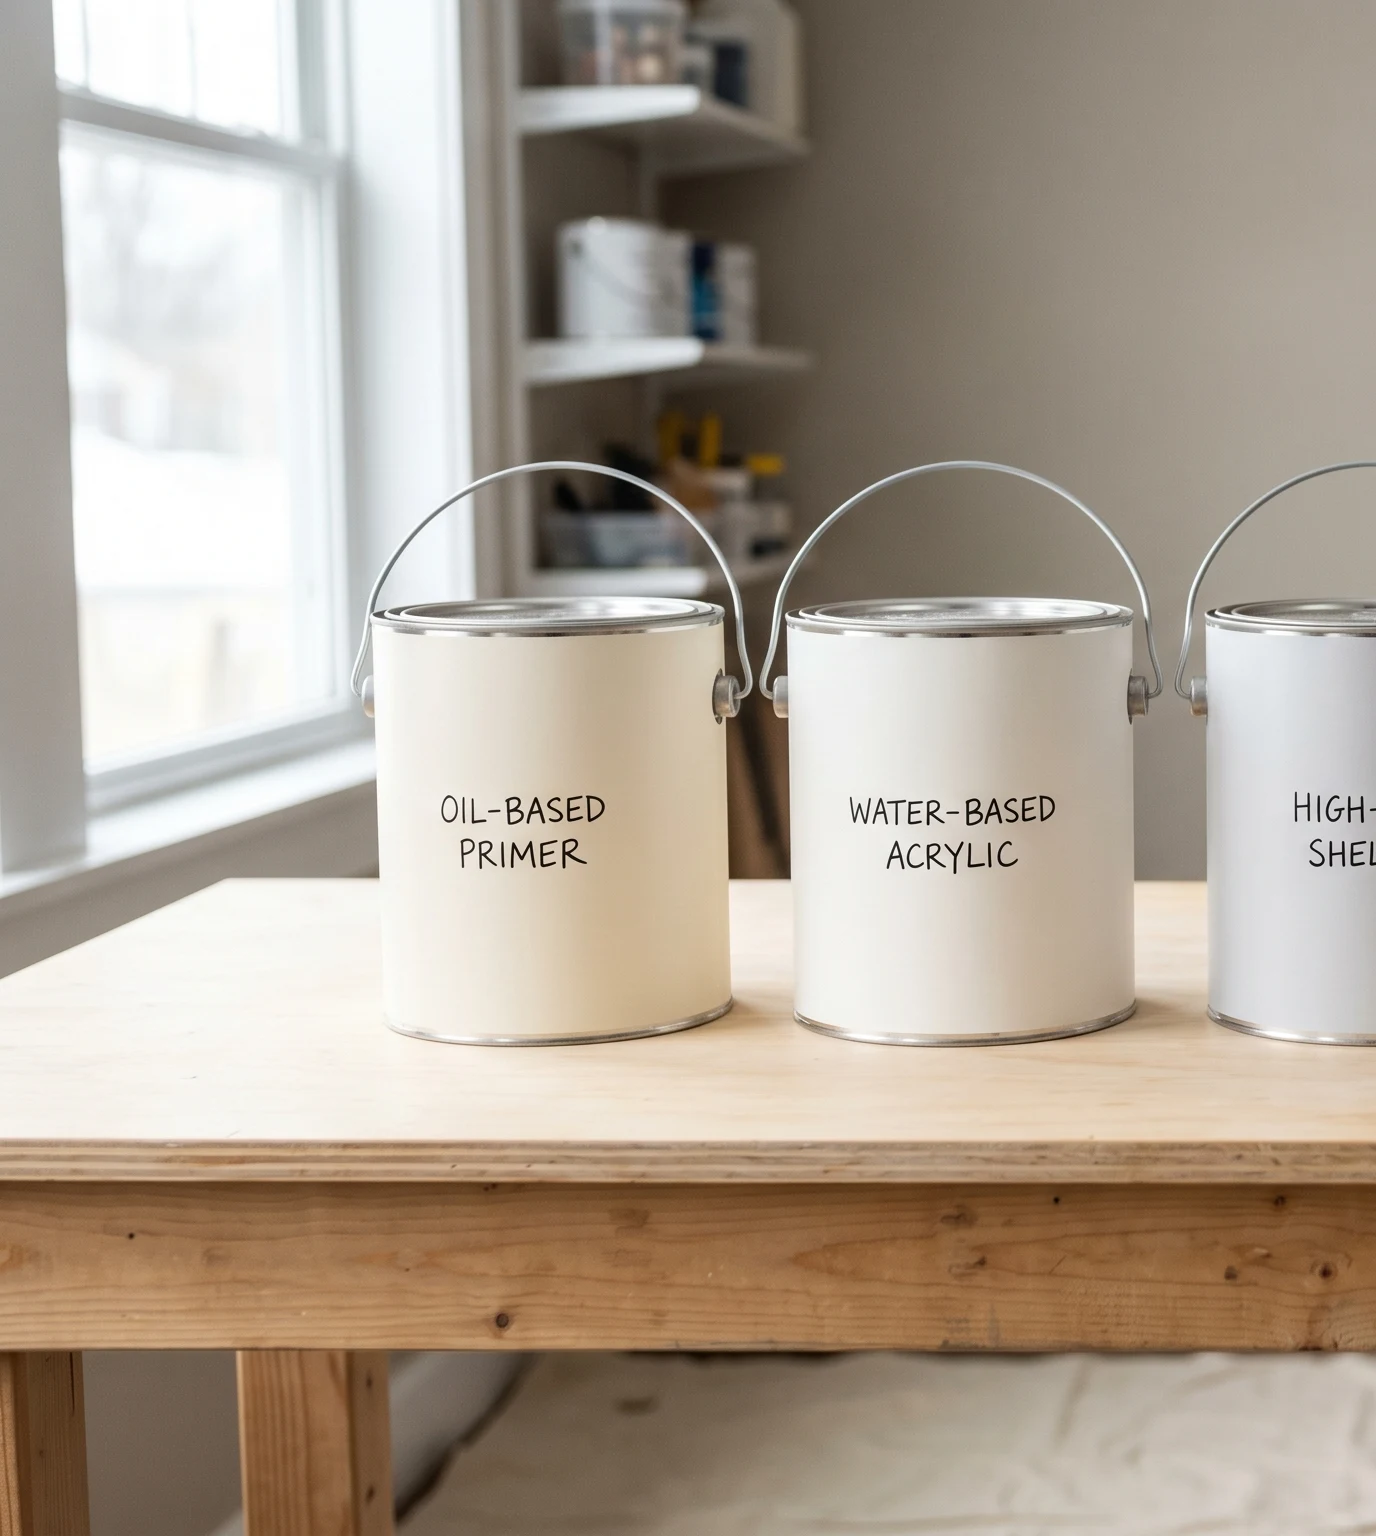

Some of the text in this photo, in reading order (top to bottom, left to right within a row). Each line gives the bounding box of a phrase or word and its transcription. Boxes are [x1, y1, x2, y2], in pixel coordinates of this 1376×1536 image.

[441, 795, 606, 825] OIL-BASED
[849, 795, 1056, 826] WATER-BASED
[459, 838, 588, 869] PRIMER
[886, 840, 1019, 874] ACRYLIC
